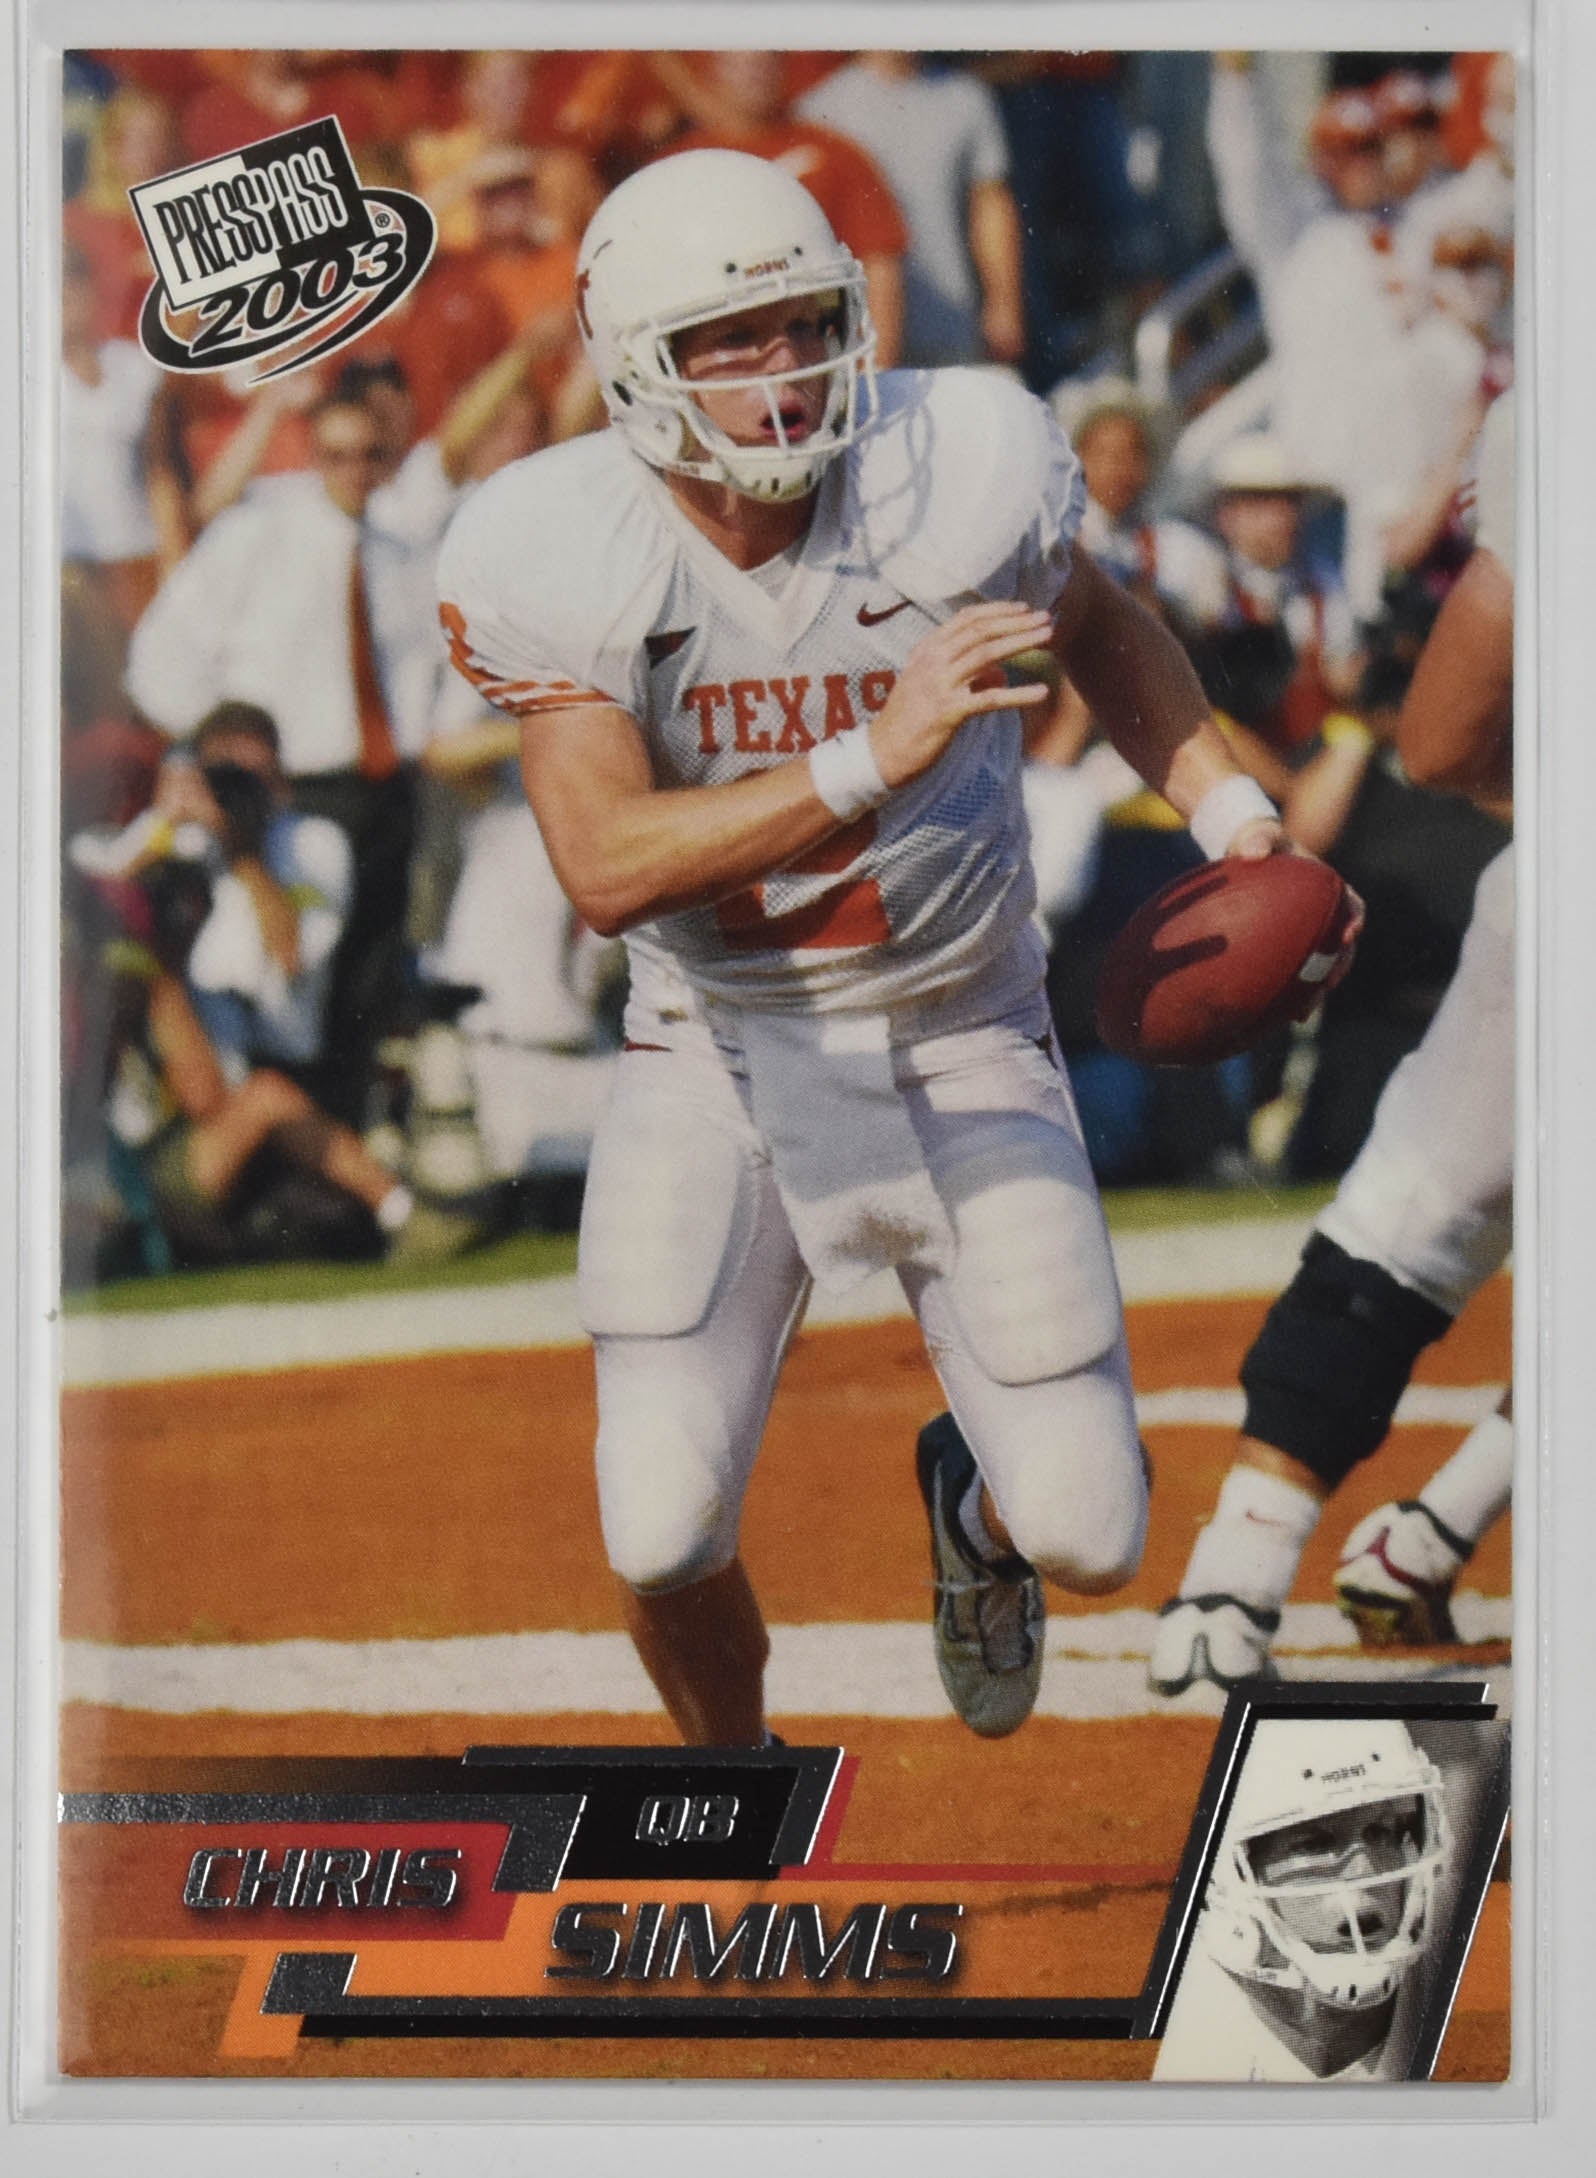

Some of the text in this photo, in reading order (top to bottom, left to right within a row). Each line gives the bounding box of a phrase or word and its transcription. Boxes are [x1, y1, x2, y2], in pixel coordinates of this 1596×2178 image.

[189, 232, 404, 357] 2003
[635, 1795, 740, 1846] QB
[183, 1848, 462, 1907] CHRIS
[544, 1903, 964, 1980] SIMMS
